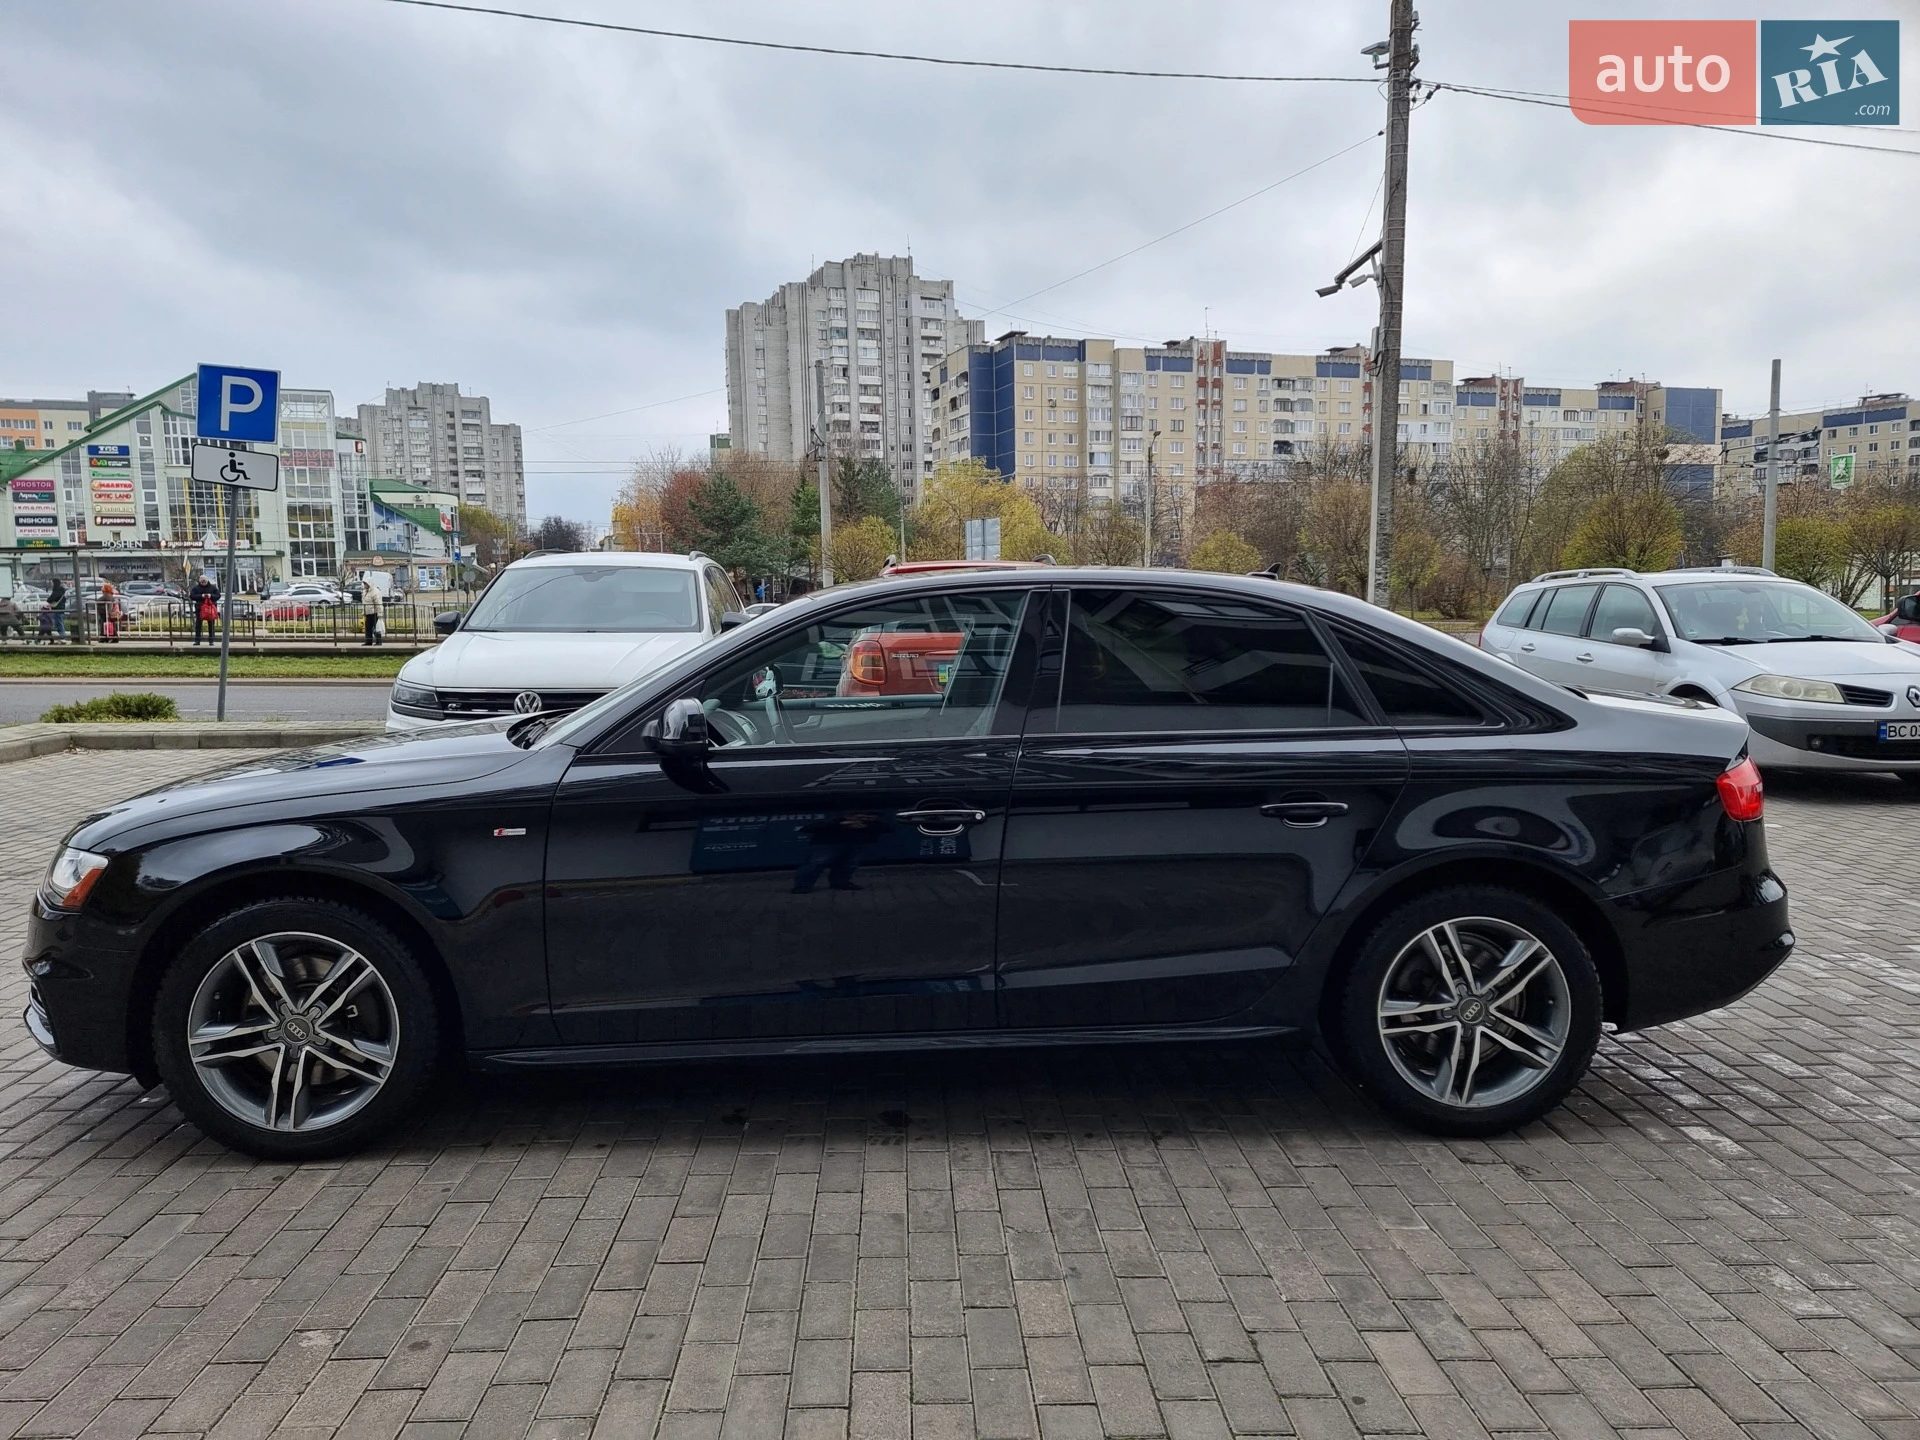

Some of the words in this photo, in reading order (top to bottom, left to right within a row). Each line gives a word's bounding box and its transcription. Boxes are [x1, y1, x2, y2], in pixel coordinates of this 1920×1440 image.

[220, 374, 263, 432] P
[101, 540, 143, 549] ROSHEN
[1888, 725, 1908, 738] BC
